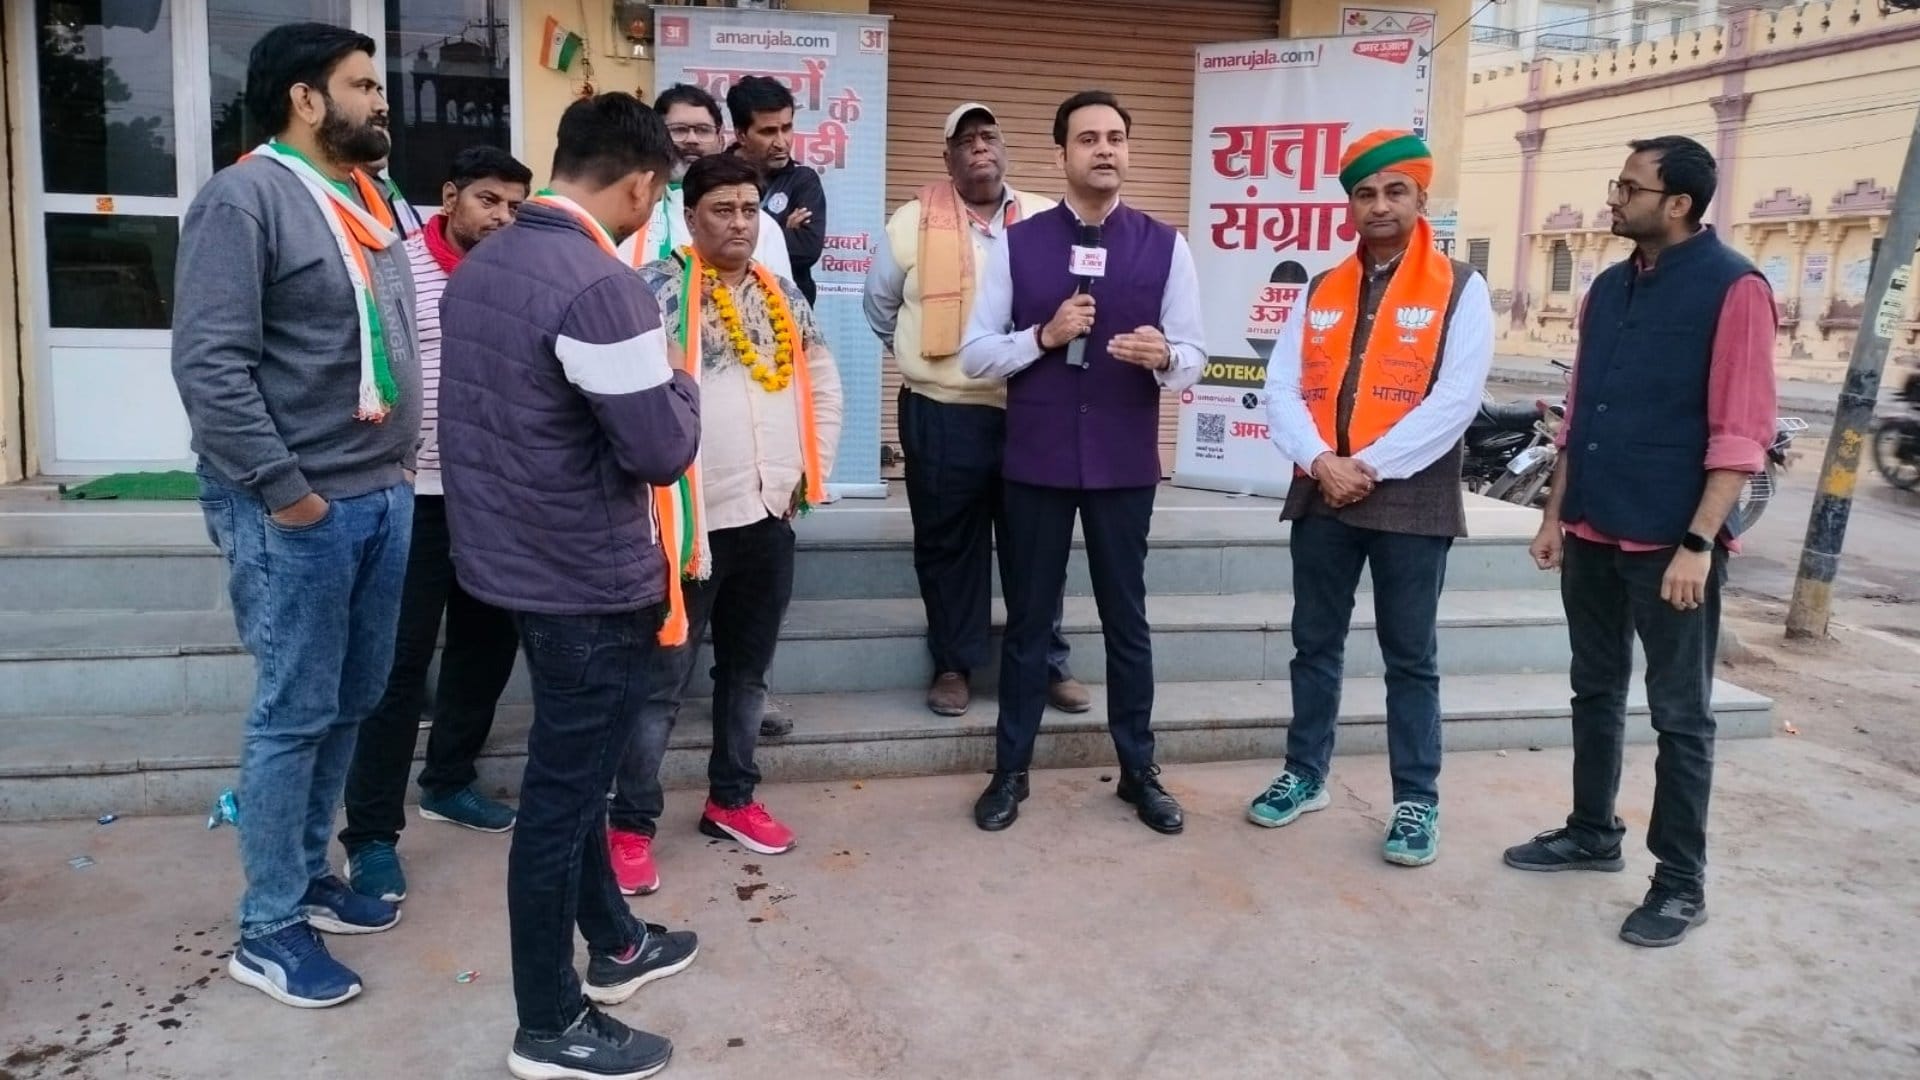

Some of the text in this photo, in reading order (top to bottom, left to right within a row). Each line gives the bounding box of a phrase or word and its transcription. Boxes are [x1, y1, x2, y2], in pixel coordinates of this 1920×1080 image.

[716, 29, 830, 49] amarujala.com
[1203, 49, 1315, 71] amarujala.com
[828, 88, 861, 123] के
[1209, 121, 1351, 192] सत्ता
[1260, 286, 1302, 303] अम
[1246, 327, 1281, 335] amaru
[1202, 362, 1266, 382] VOTEKA
[1229, 421, 1271, 440] अमर
